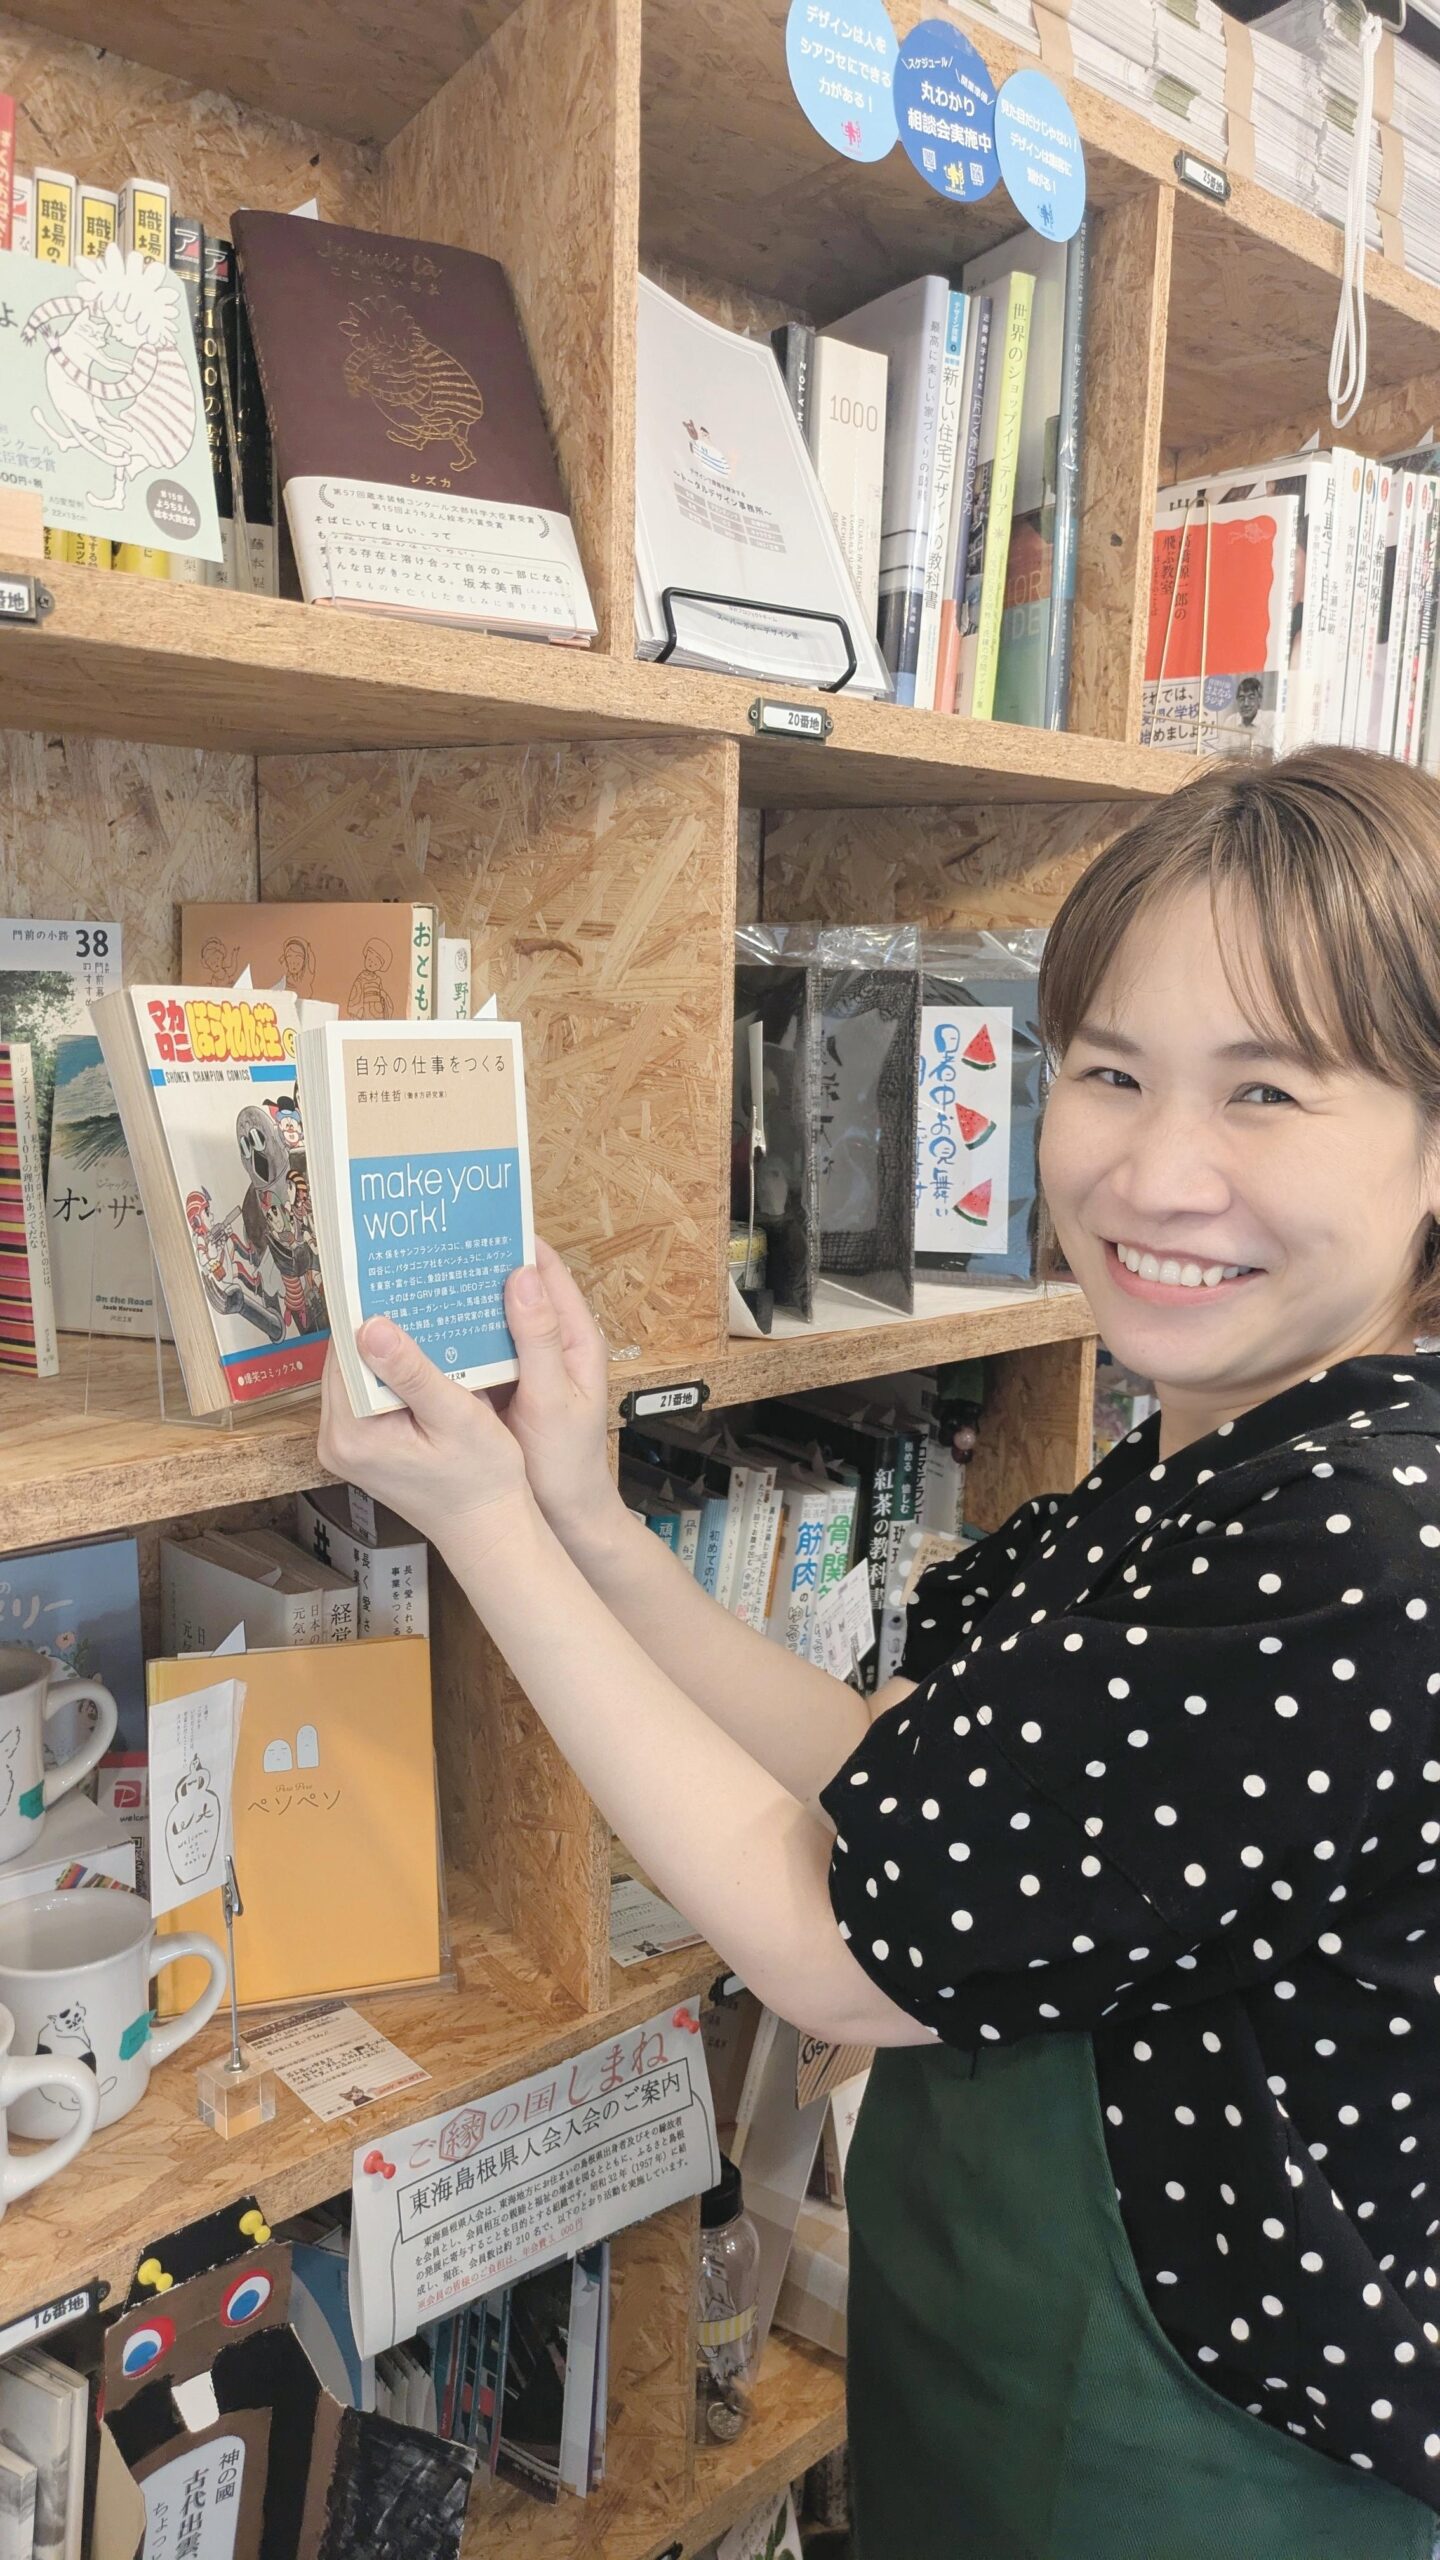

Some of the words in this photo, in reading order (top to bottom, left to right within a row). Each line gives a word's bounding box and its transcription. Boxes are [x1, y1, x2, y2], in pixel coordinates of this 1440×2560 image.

[806, 5, 887, 54] デザインは人を
[800, 37, 892, 88] シアワセにできる
[907, 57, 949, 69] スケジュール
[818, 76, 873, 113] 力がある!
[920, 80, 975, 117] 丸わかり
[907, 107, 992, 154] 相談会実施中
[41, 199, 68, 263] 職場の
[829, 394, 879, 432] 1000
[996, 303, 1029, 518] 世界のショップインテリア
[409, 472, 452, 489] シズカ
[314, 515, 451, 541] そばにいてほしい、って
[788, 711, 820, 731] 20番地
[12, 929, 68, 941] 門前の小路
[75, 929, 109, 958] 38
[413, 921, 431, 1020] おとも
[184, 1000, 286, 1063] ほうれん荘
[194, 1070, 224, 1082] CHAMPION
[227, 1069, 250, 1082] COMICS
[356, 1054, 505, 1076] 自分の仕事をつくる
[357, 1089, 401, 1103] 西村佳哲
[360, 1162, 443, 1201] make
[446, 1162, 512, 1204] your
[363, 1198, 447, 1241] work!
[660, 1392, 693, 1408] 21番地
[868, 1468, 896, 1610] 紅茶の教科書
[703, 1529, 721, 1593] 初めてのハ
[391, 1567, 401, 1636] 事業をつくる
[403, 1565, 413, 1634] 長く愛される
[331, 1603, 352, 1642] 経営
[247, 1790, 341, 1816] ペソペソ
[406, 2031, 668, 2171] ご縁の国しまね
[408, 2072, 681, 2219] 東海島根県人会入会のご案内
[34, 2295, 84, 2329] 16番地
[215, 2448, 240, 2504] 神の國
